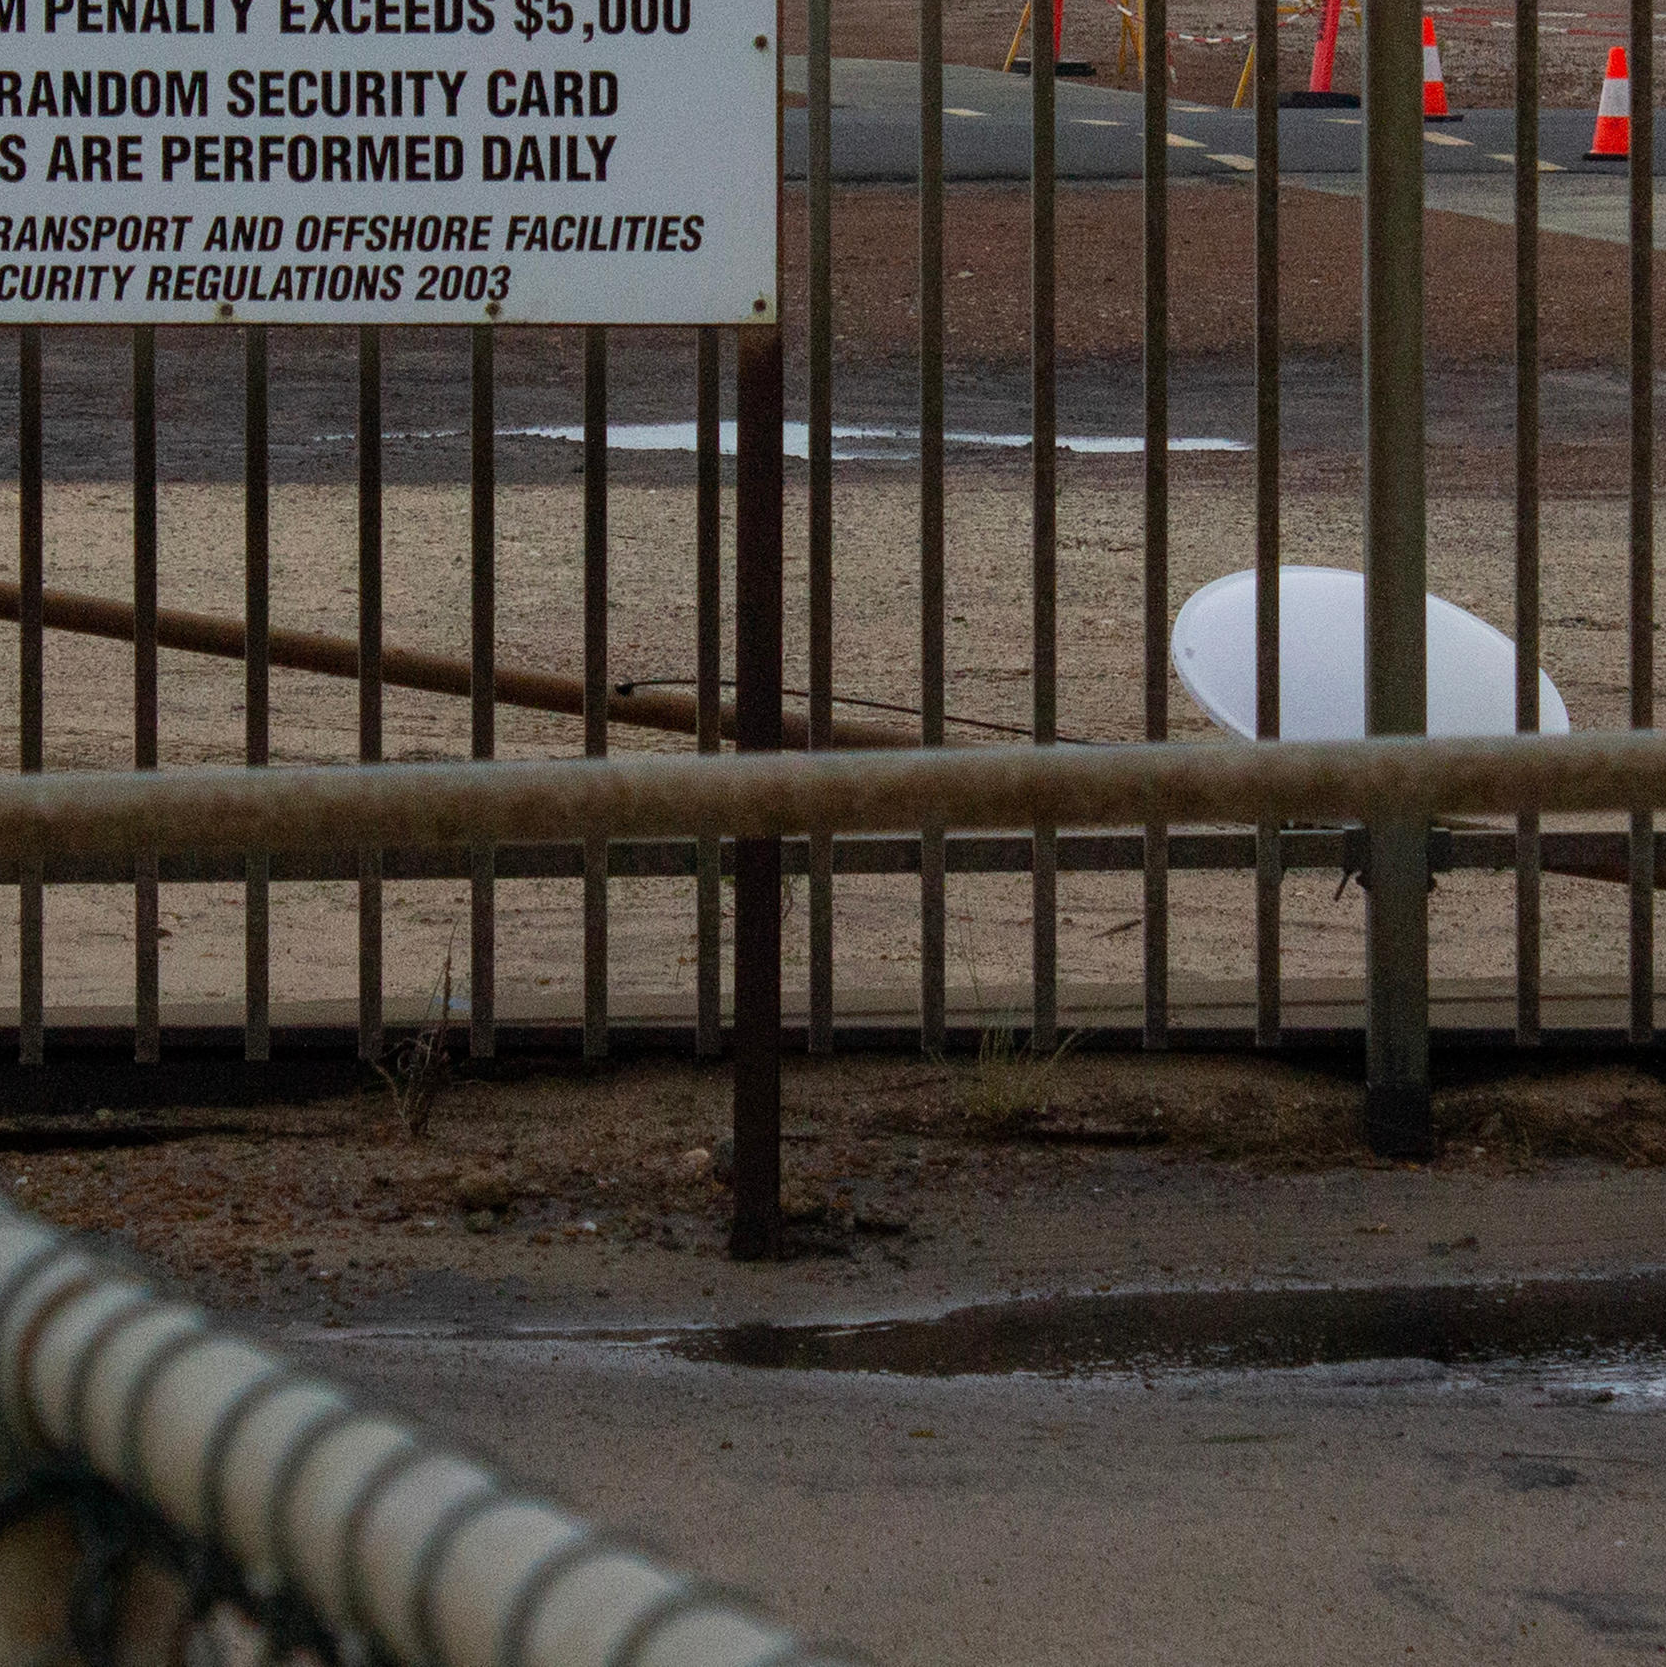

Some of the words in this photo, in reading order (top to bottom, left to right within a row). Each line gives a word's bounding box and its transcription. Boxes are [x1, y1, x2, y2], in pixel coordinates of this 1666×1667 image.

[227, 69, 467, 119] SECURITY
[487, 69, 619, 118] CARD
[46, 135, 143, 182] ARE
[162, 134, 464, 183] PERFORMED
[482, 135, 616, 182] DAILY
[203, 215, 284, 252] AND
[295, 214, 493, 253] OFFSHORE
[505, 214, 705, 253] FACILITIES
[146, 264, 405, 303] REGULATIONS
[415, 264, 512, 303] 2003
